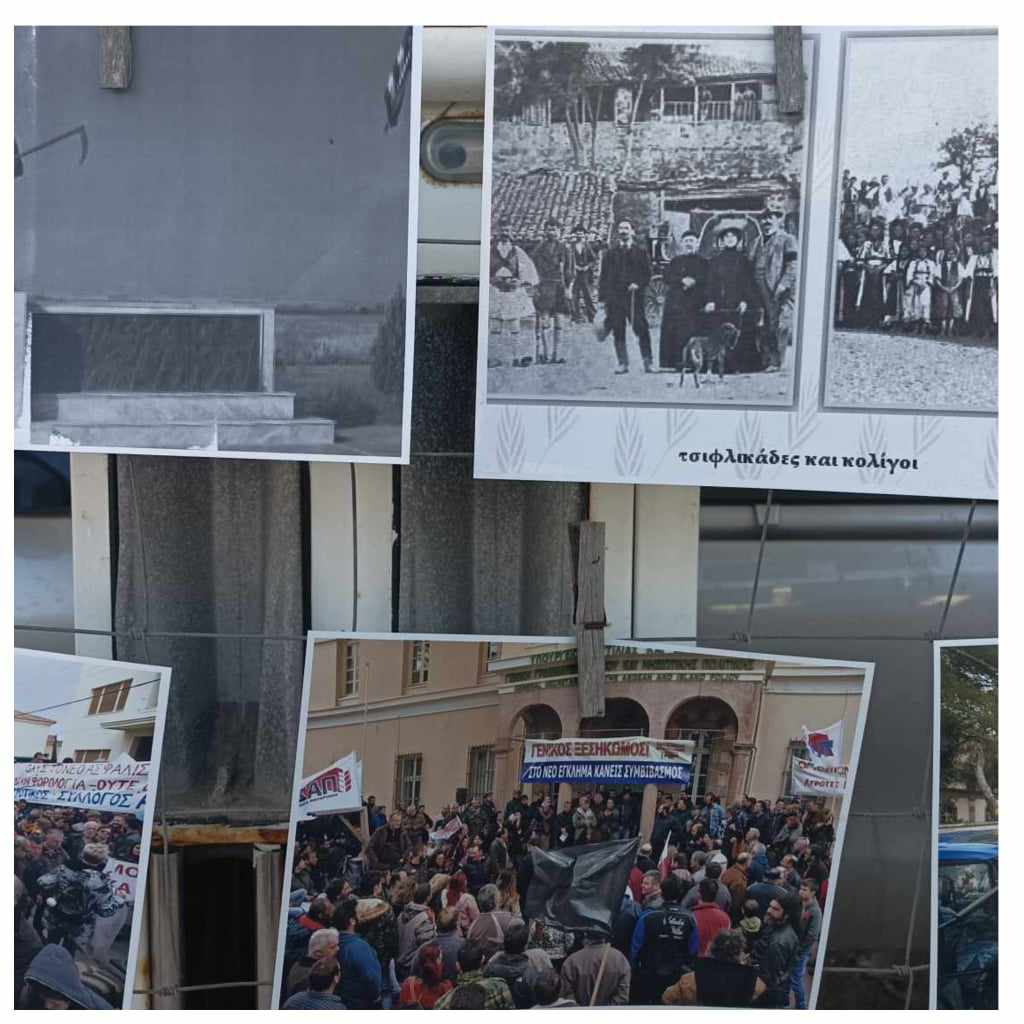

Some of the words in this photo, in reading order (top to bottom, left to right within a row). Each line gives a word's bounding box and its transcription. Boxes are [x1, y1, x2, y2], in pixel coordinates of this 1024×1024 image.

[678, 448, 800, 469] τσιφλικάδες
[804, 453, 839, 467] και
[842, 451, 919, 475] κολίγοι
[528, 765, 542, 779] ΣΤΟ
[543, 765, 557, 778] ΝΕΟ
[558, 764, 592, 778] ΕΓΚΛΗΜΑ
[623, 764, 683, 779] ΣΥΜΒΙΒΑΣΜΟΣ
[56, 790, 133, 808] ΣΥΛΛΟΓΟΣ
